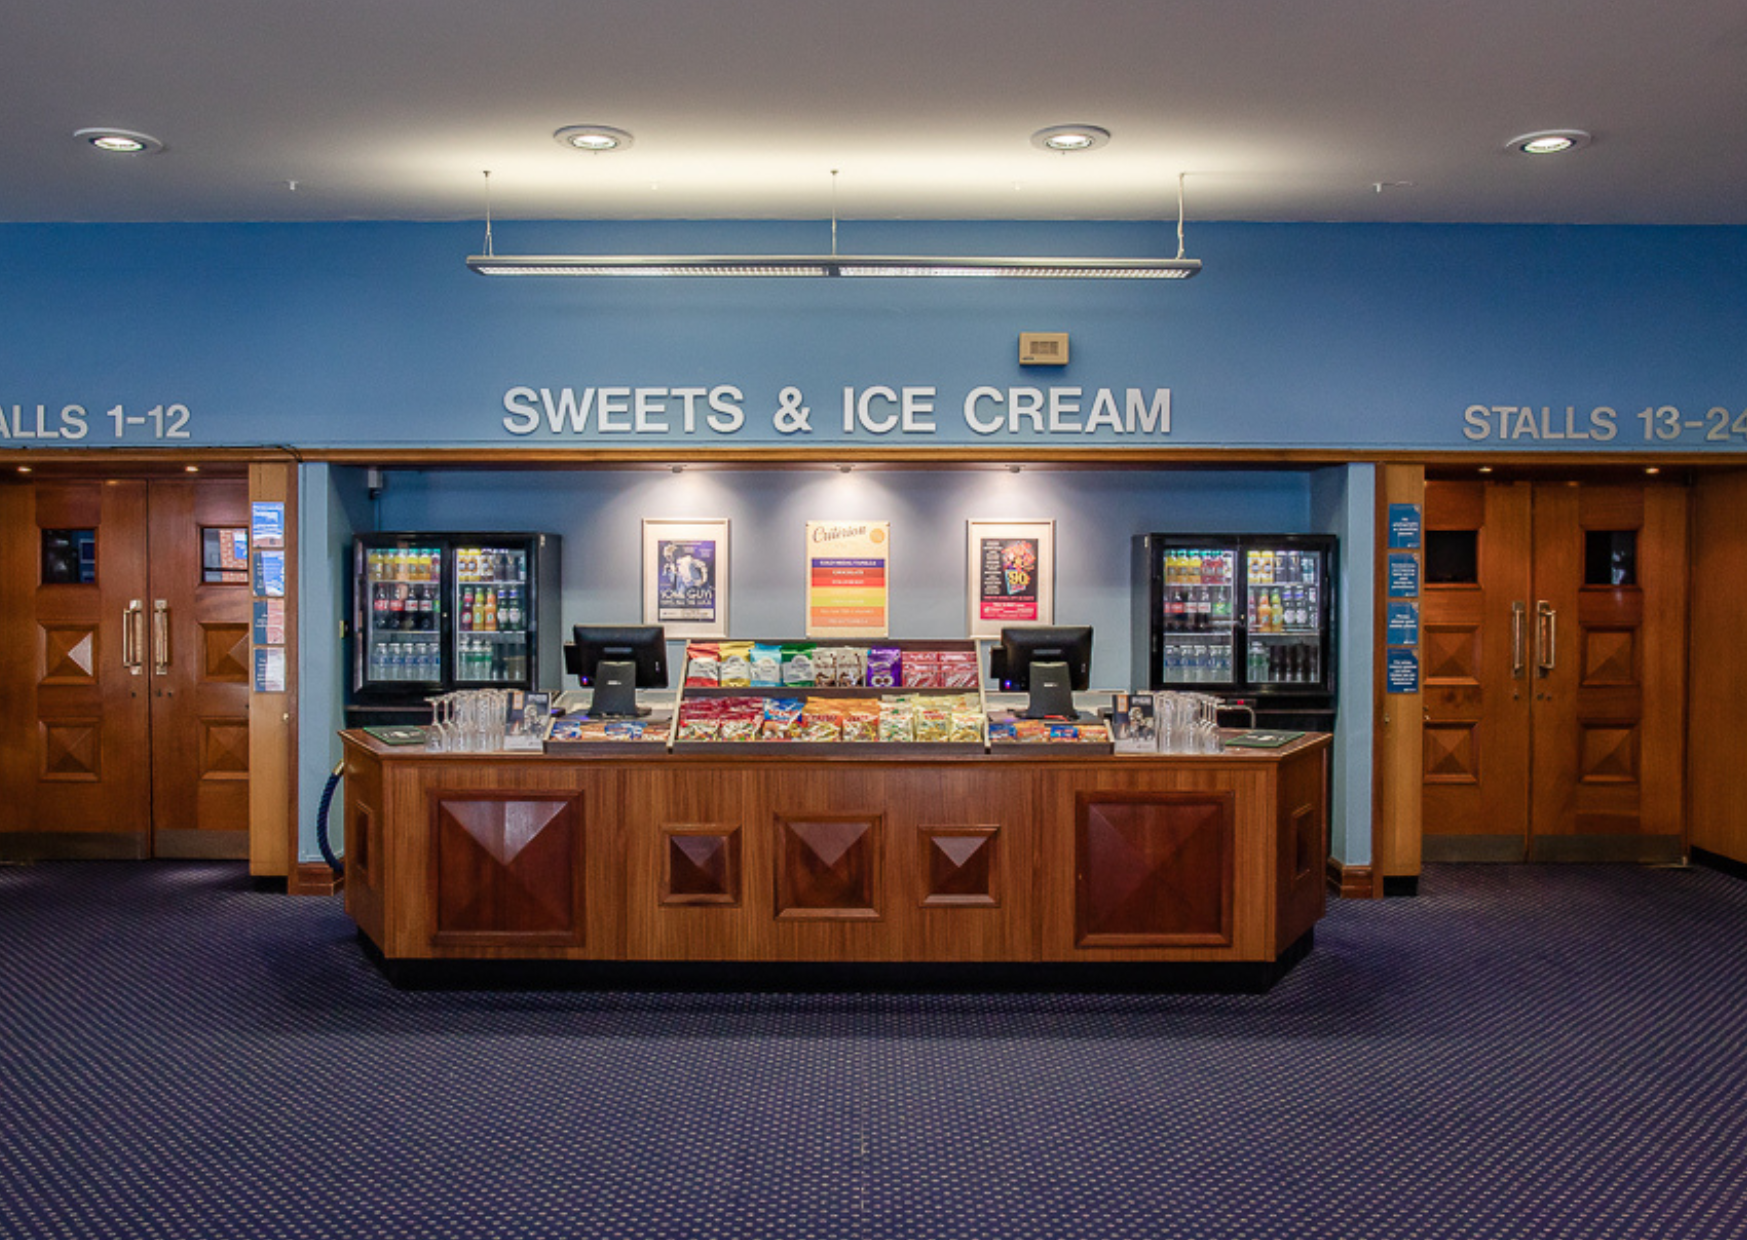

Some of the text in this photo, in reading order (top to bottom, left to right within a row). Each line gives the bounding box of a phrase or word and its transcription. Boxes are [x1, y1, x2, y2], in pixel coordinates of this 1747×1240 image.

[108, 404, 190, 438] 1-12
[503, 385, 1171, 434] SWEETS & ICE CREAM
[1463, 405, 1747, 440] STALLS 13-24
[813, 526, 866, 543] Criterion
